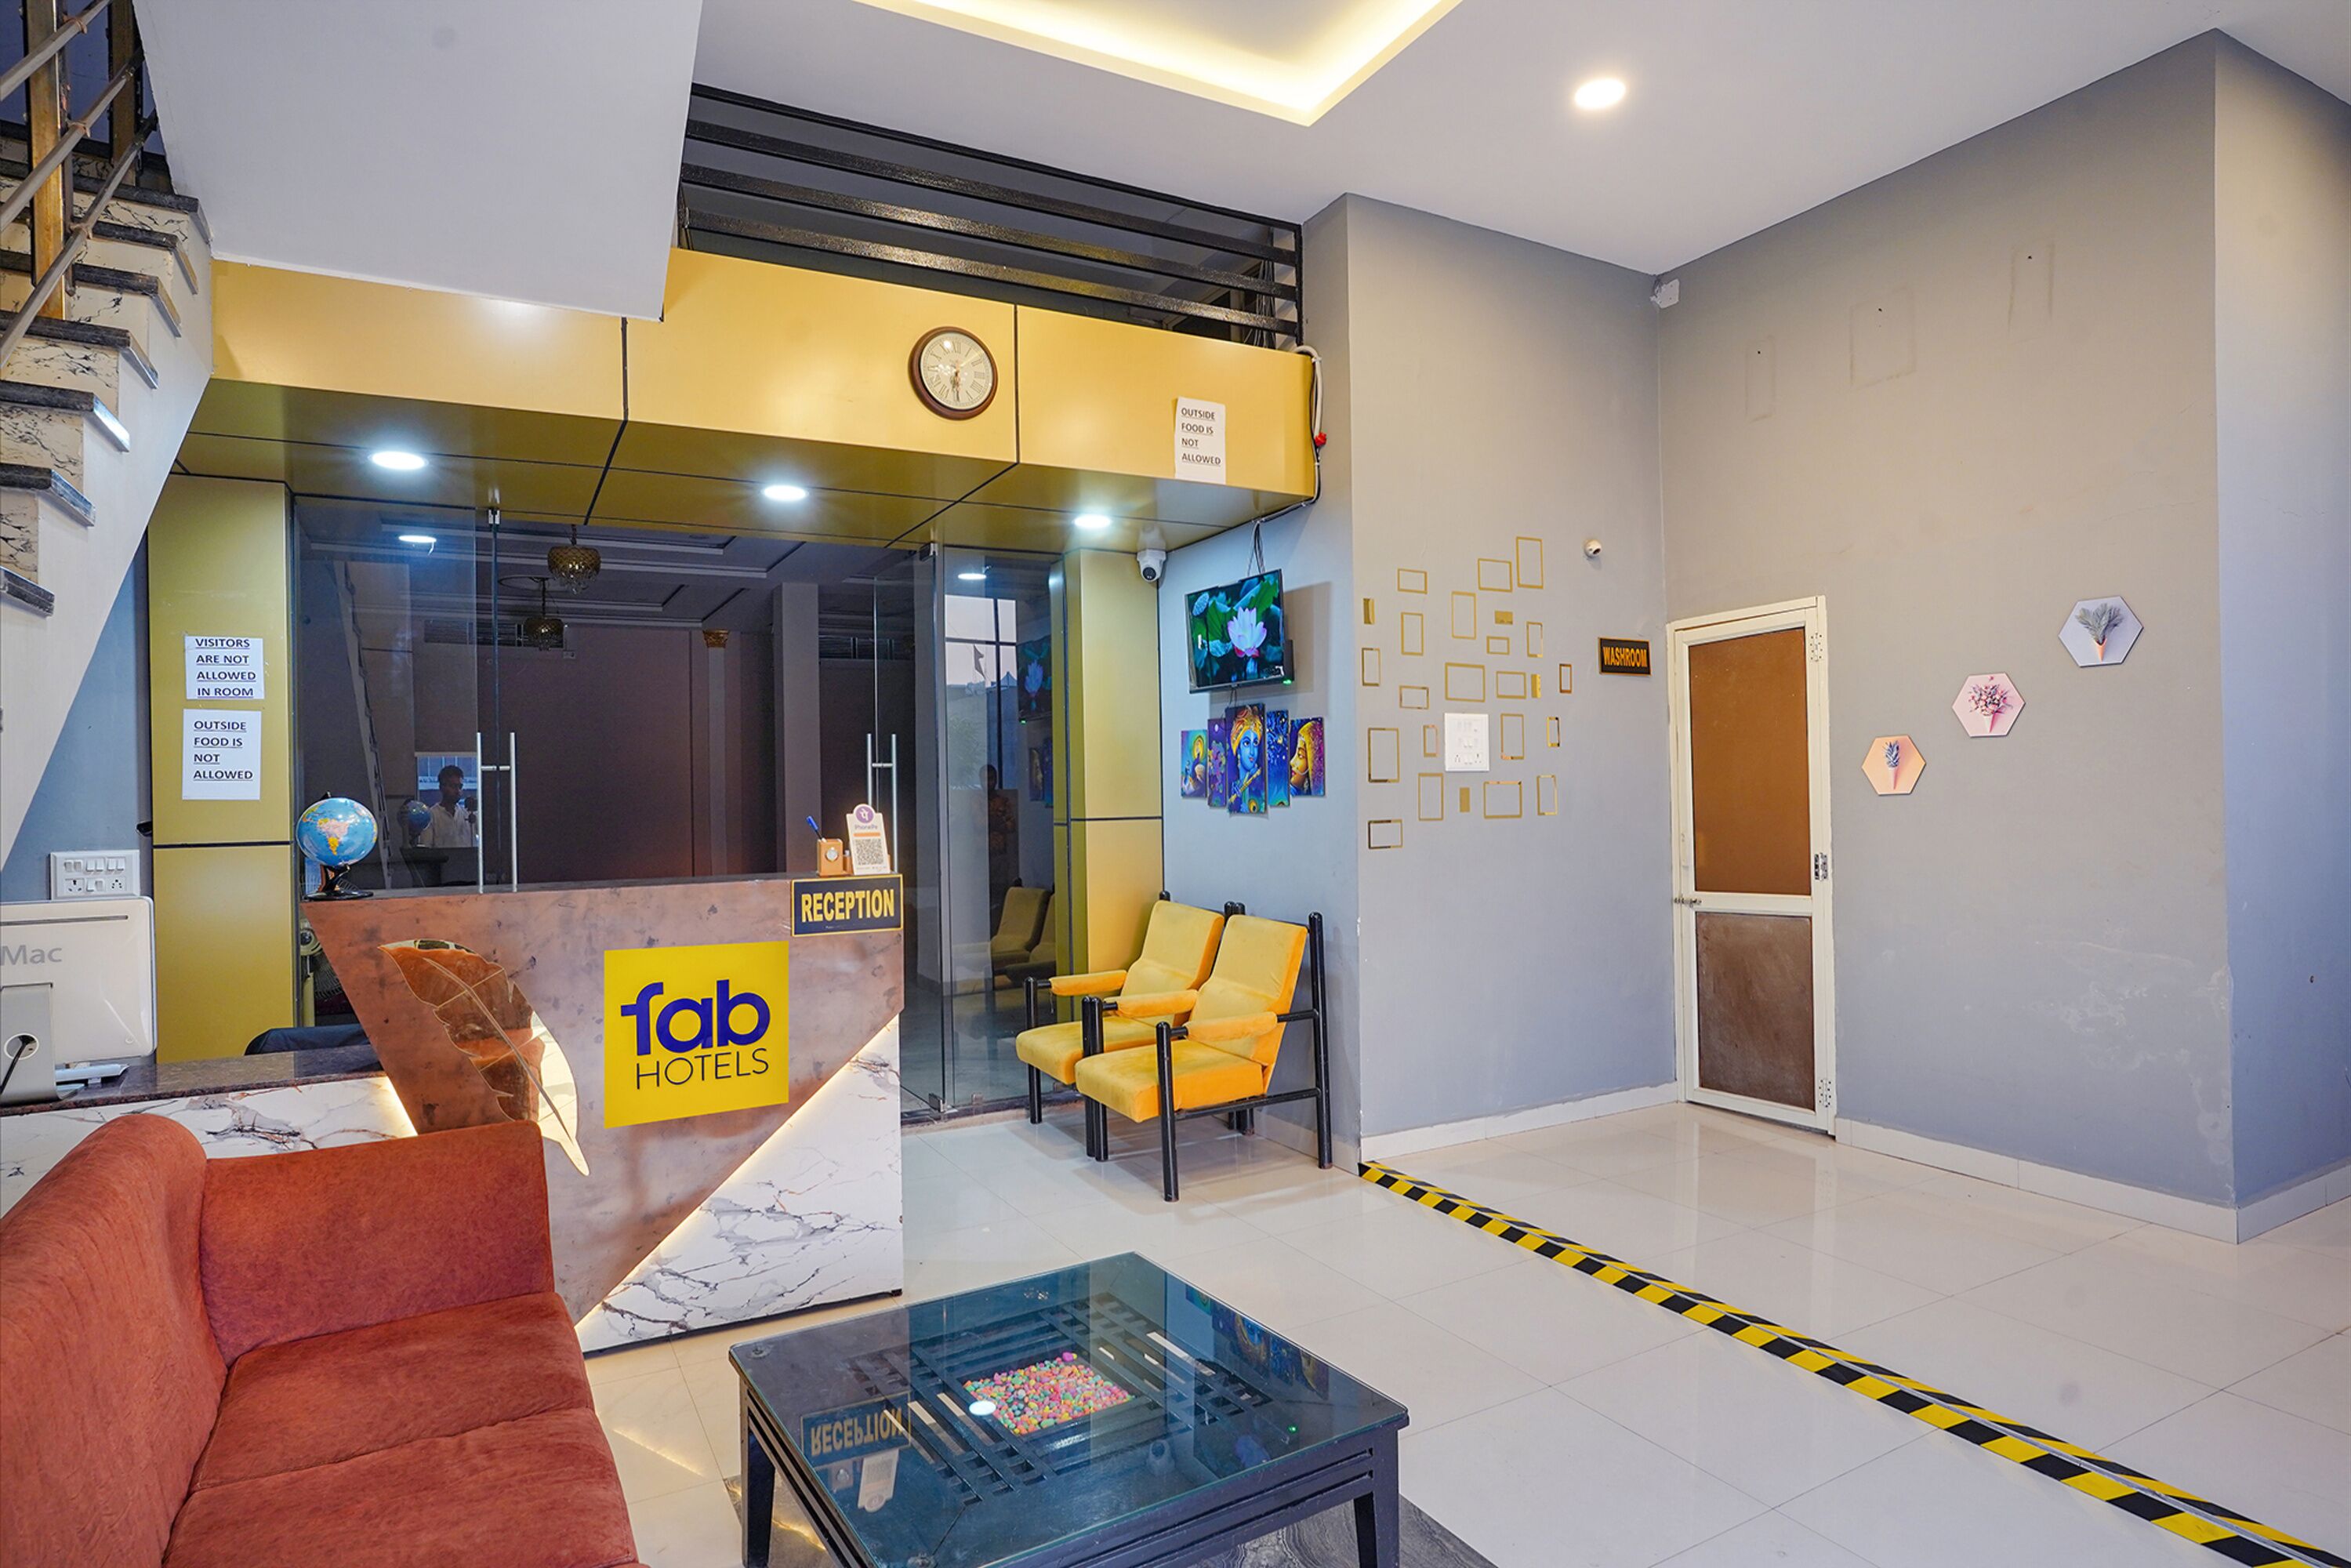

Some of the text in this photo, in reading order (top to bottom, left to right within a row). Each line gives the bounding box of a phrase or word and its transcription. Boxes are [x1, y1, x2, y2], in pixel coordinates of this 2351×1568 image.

[1181, 407, 1216, 420] OUTSIDE
[1181, 423, 1214, 435] FOOD IS
[1181, 437, 1199, 448] NOT
[1181, 452, 1221, 465] ALLOWED
[195, 638, 250, 648] VISITORS
[196, 655, 249, 664] ARE NOT
[1602, 646, 1648, 667] WASHROOM
[197, 671, 256, 681] ALLOWED
[197, 688, 254, 697] IN ROOM
[194, 720, 247, 731] OUTSIDE
[194, 737, 243, 747] FOOD IS
[194, 753, 220, 763] NOT
[193, 770, 253, 779] ALLOWED
[801, 888, 894, 923] RECEPTION
[620, 978, 771, 1056] fab
[637, 1047, 769, 1090] HOTELS
